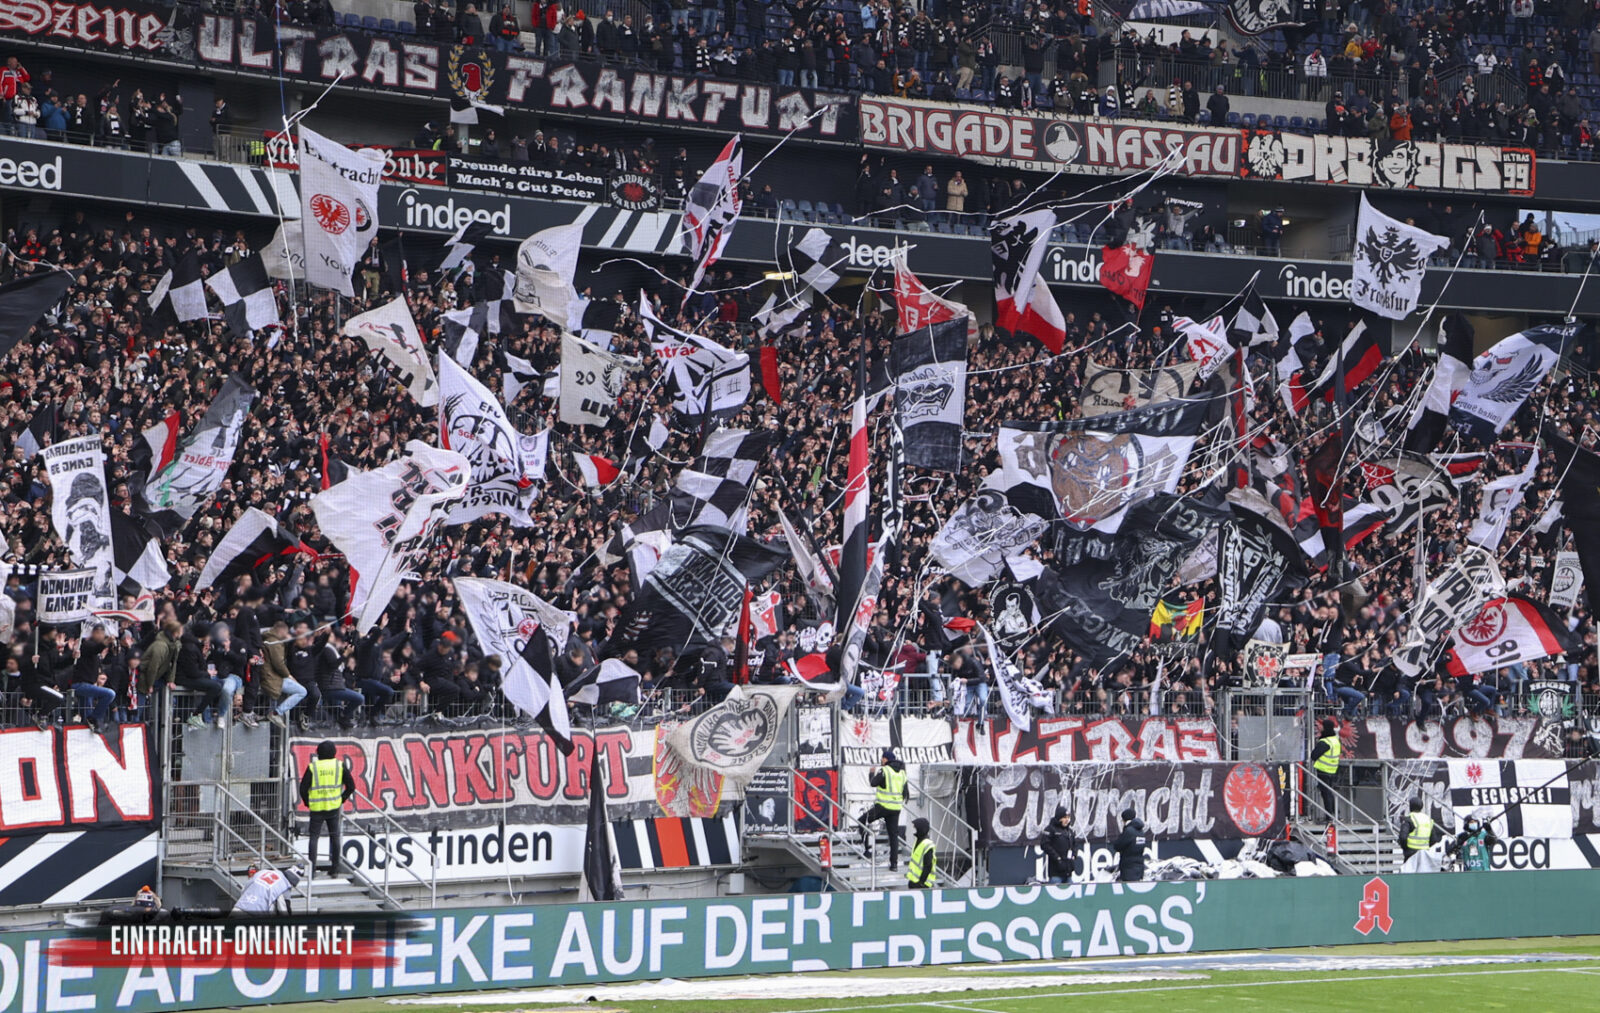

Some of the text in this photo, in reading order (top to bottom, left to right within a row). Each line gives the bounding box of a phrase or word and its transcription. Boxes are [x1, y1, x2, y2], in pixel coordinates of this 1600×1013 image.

[200, 13, 849, 136] ULTRAS FRANKFURT
[859, 101, 1240, 177] BRIGADE NASSAU
[1503, 153, 1530, 164] ULTRAS
[450, 158, 604, 186] Freunde fürs Leben
[995, 158, 1115, 176] HOOLIGANS
[1503, 162, 1529, 190] 99
[517, 182, 548, 194] Gut
[551, 184, 596, 200] Peter
[403, 190, 511, 236] indeed
[840, 236, 909, 268] deed
[1279, 264, 1352, 300] indee
[575, 371, 597, 386] 20
[45, 596, 75, 612] GANG
[953, 716, 1222, 763] ULTRAS
[1366, 716, 1538, 760] 1997
[0, 723, 154, 829] ON
[289, 730, 632, 816] FRANKFURT
[988, 763, 1216, 844] Eintracht
[343, 830, 553, 870] obs finden
[549, 905, 688, 979] AUF
